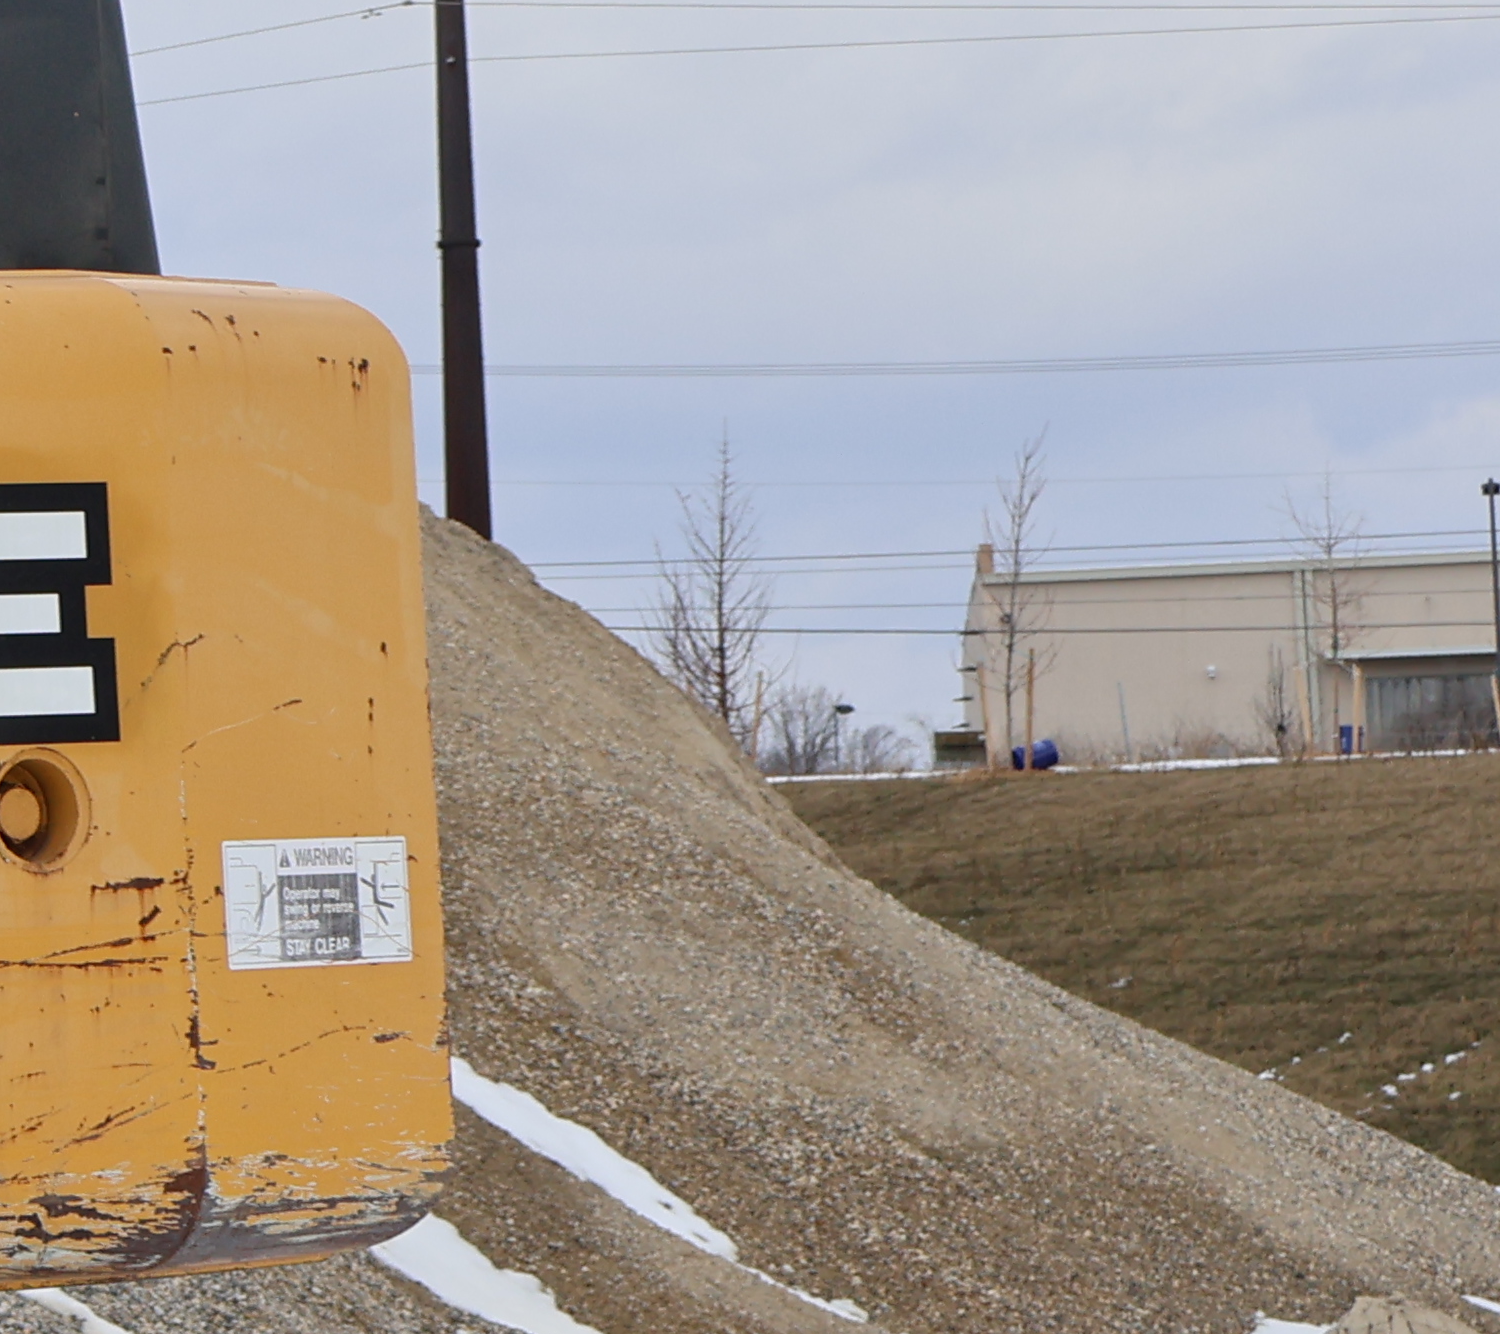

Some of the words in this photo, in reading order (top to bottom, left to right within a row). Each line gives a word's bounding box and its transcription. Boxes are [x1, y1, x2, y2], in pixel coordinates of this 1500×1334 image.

[293, 847, 353, 866] WARNING
[286, 938, 311, 956] STAY
[315, 936, 350, 955] CLEAR
